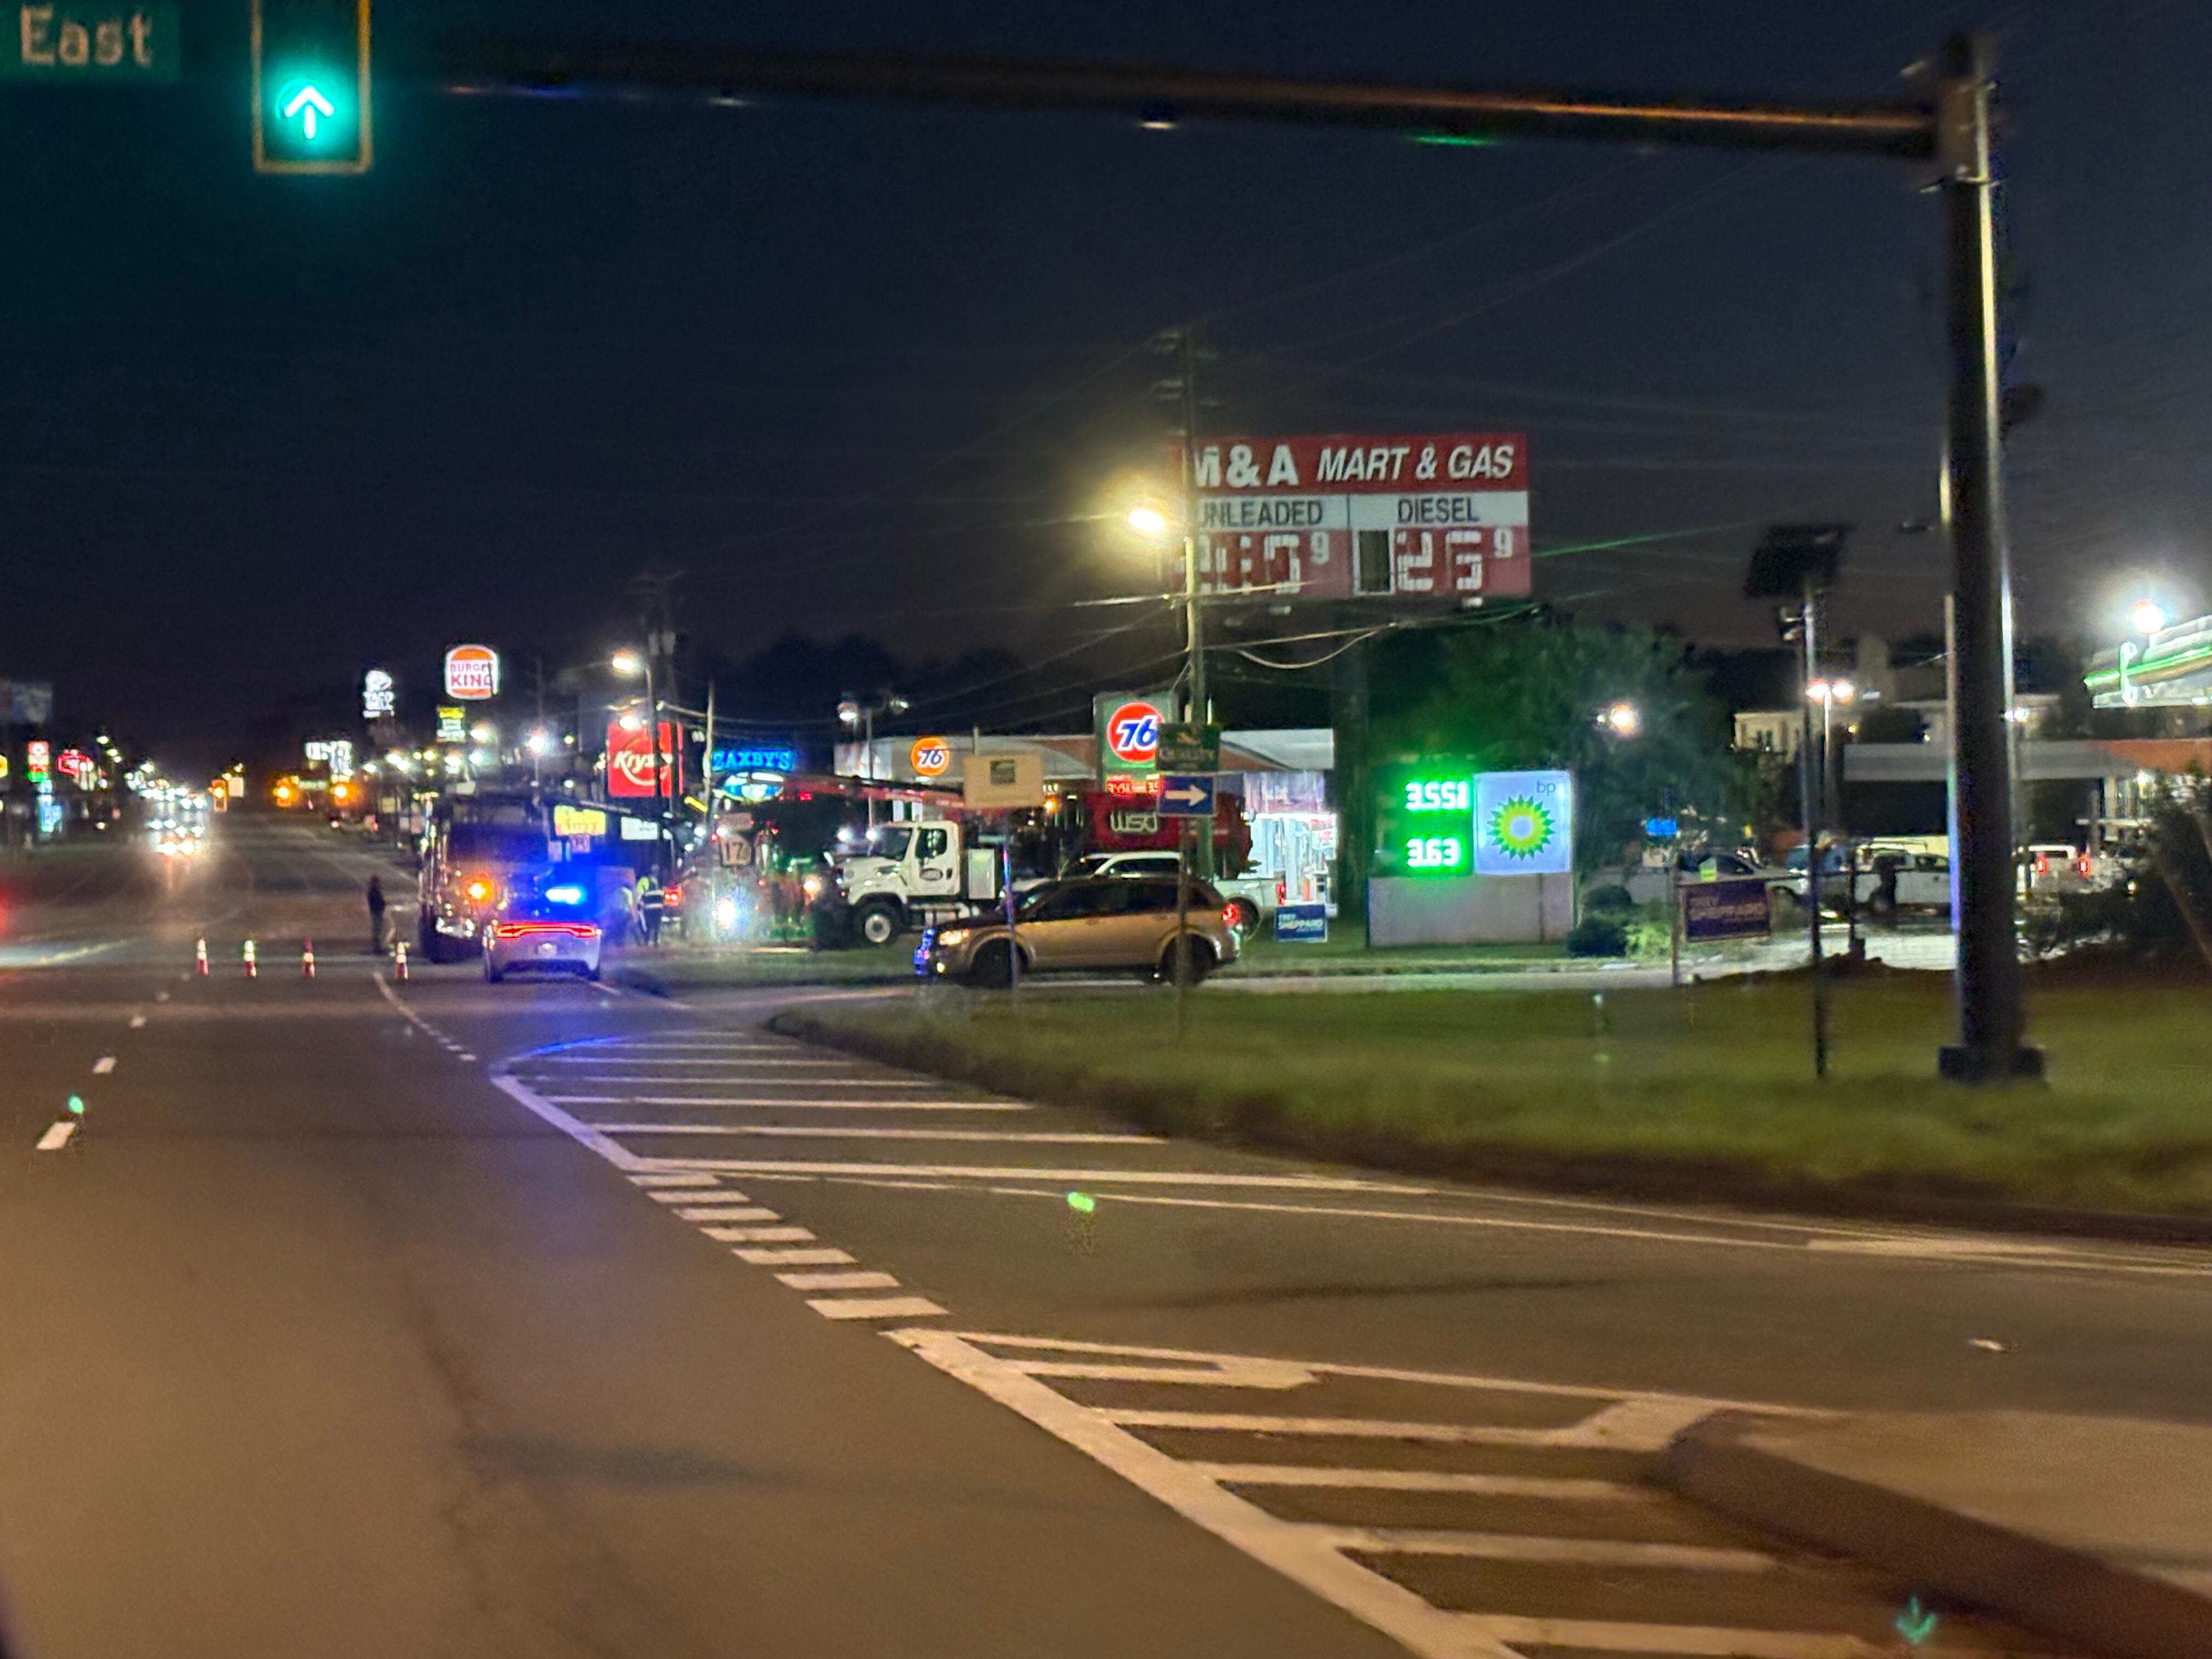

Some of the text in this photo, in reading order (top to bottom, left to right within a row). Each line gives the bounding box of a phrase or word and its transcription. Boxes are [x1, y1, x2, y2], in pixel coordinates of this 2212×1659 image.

[20, 4, 152, 68] East
[1316, 446, 1410, 483] MART
[1415, 446, 1438, 480] &
[1448, 445, 1514, 480] GAS
[1397, 496, 1480, 523] DIESEL
[1118, 716, 1157, 750] 76
[712, 750, 791, 771] ZAXBY'S
[919, 749, 943, 766] 76
[1537, 782, 1556, 796] bp
